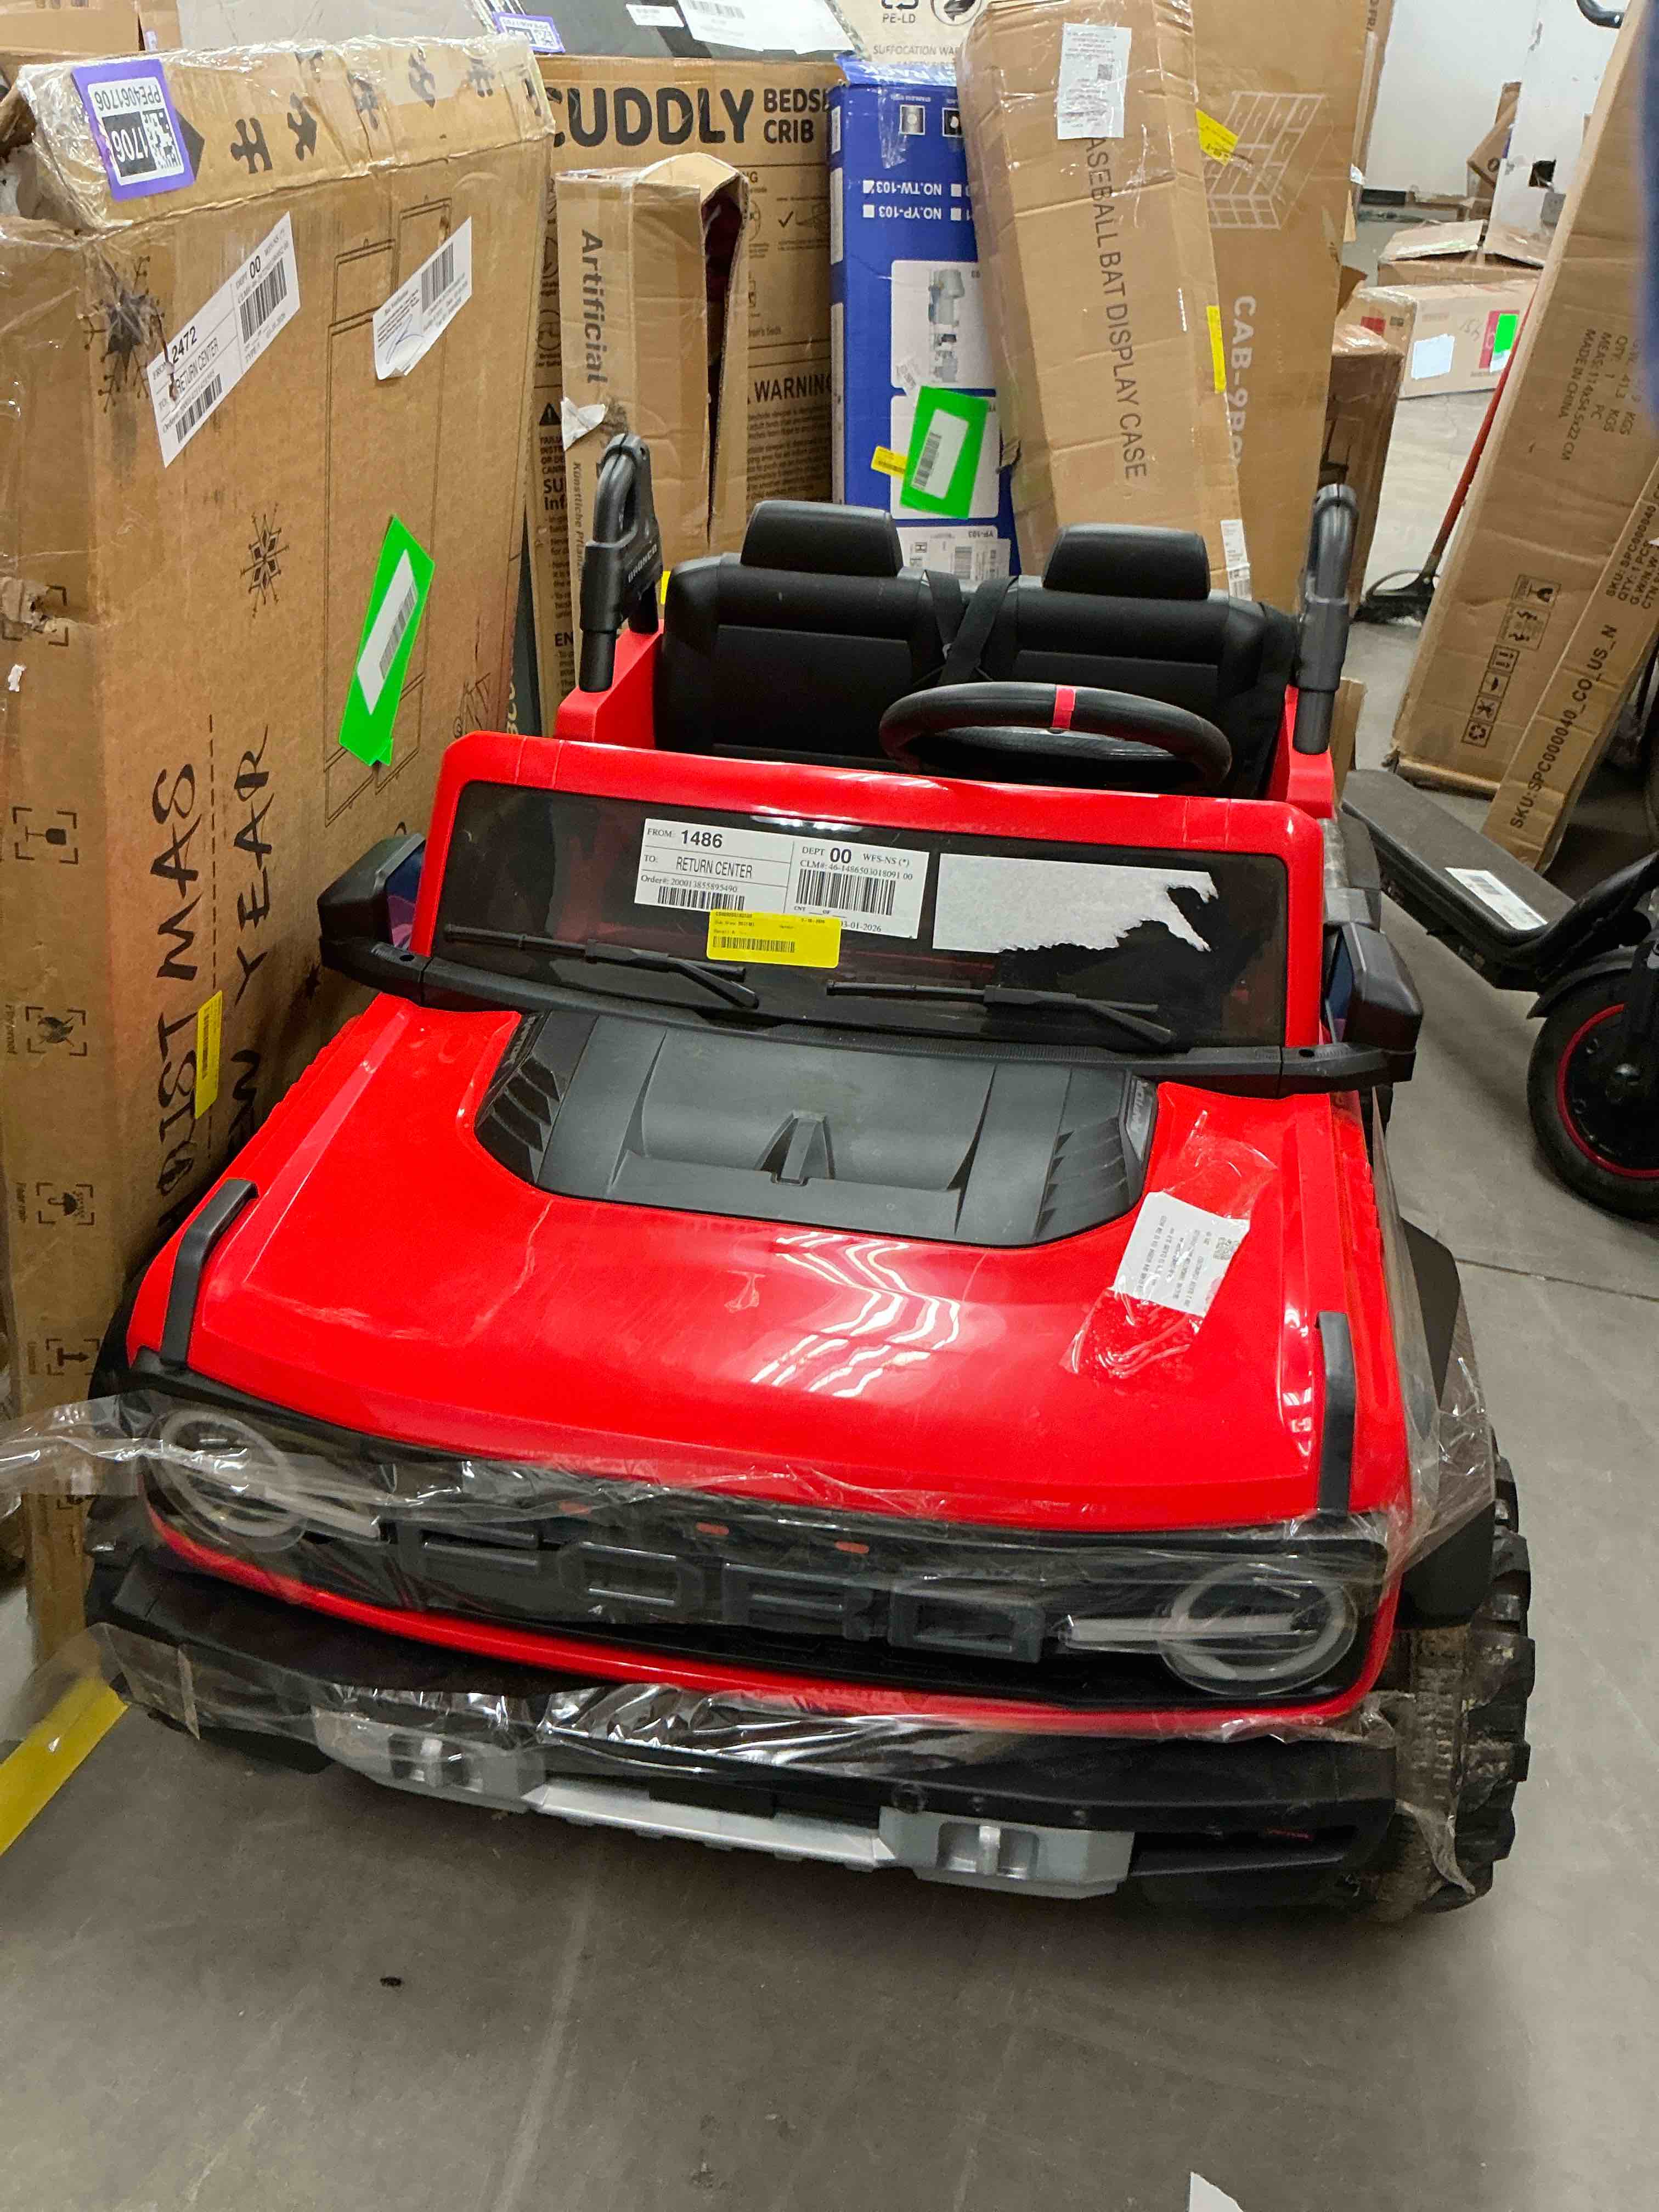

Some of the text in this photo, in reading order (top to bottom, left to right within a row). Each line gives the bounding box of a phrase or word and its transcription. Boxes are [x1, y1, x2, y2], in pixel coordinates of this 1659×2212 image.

[882, 13, 916, 24] PE-LD
[873, 44, 936, 55] SUFFOCATION
[94, 85, 161, 112] PPE4061706
[111, 127, 148, 163] 1706
[764, 119, 814, 144] CRIB
[876, 181, 942, 196] NO.TW-103
[1085, 137, 1116, 254] ASEBALL
[878, 205, 942, 220] NO.YP-103
[249, 253, 262, 281] 00
[1099, 252, 1128, 298] BAT
[580, 229, 608, 384] Artificial
[170, 323, 197, 366] 2472
[197, 335, 219, 373] CENTER
[1107, 301, 1141, 419] DISPLAY
[1575, 329, 1596, 365] MADE
[1558, 381, 1578, 418] CHINA
[1118, 415, 1147, 480] CASE
[647, 827, 724, 849] FROM: 1486
[233, 725, 274, 1006] YEAR
[644, 854, 753, 879] TO: RETURN CENTER
[802, 846, 825, 856] DEPT
[829, 847, 853, 865] 00
[862, 854, 897, 865] WFS-NS
[640, 874, 668, 884] Order#:
